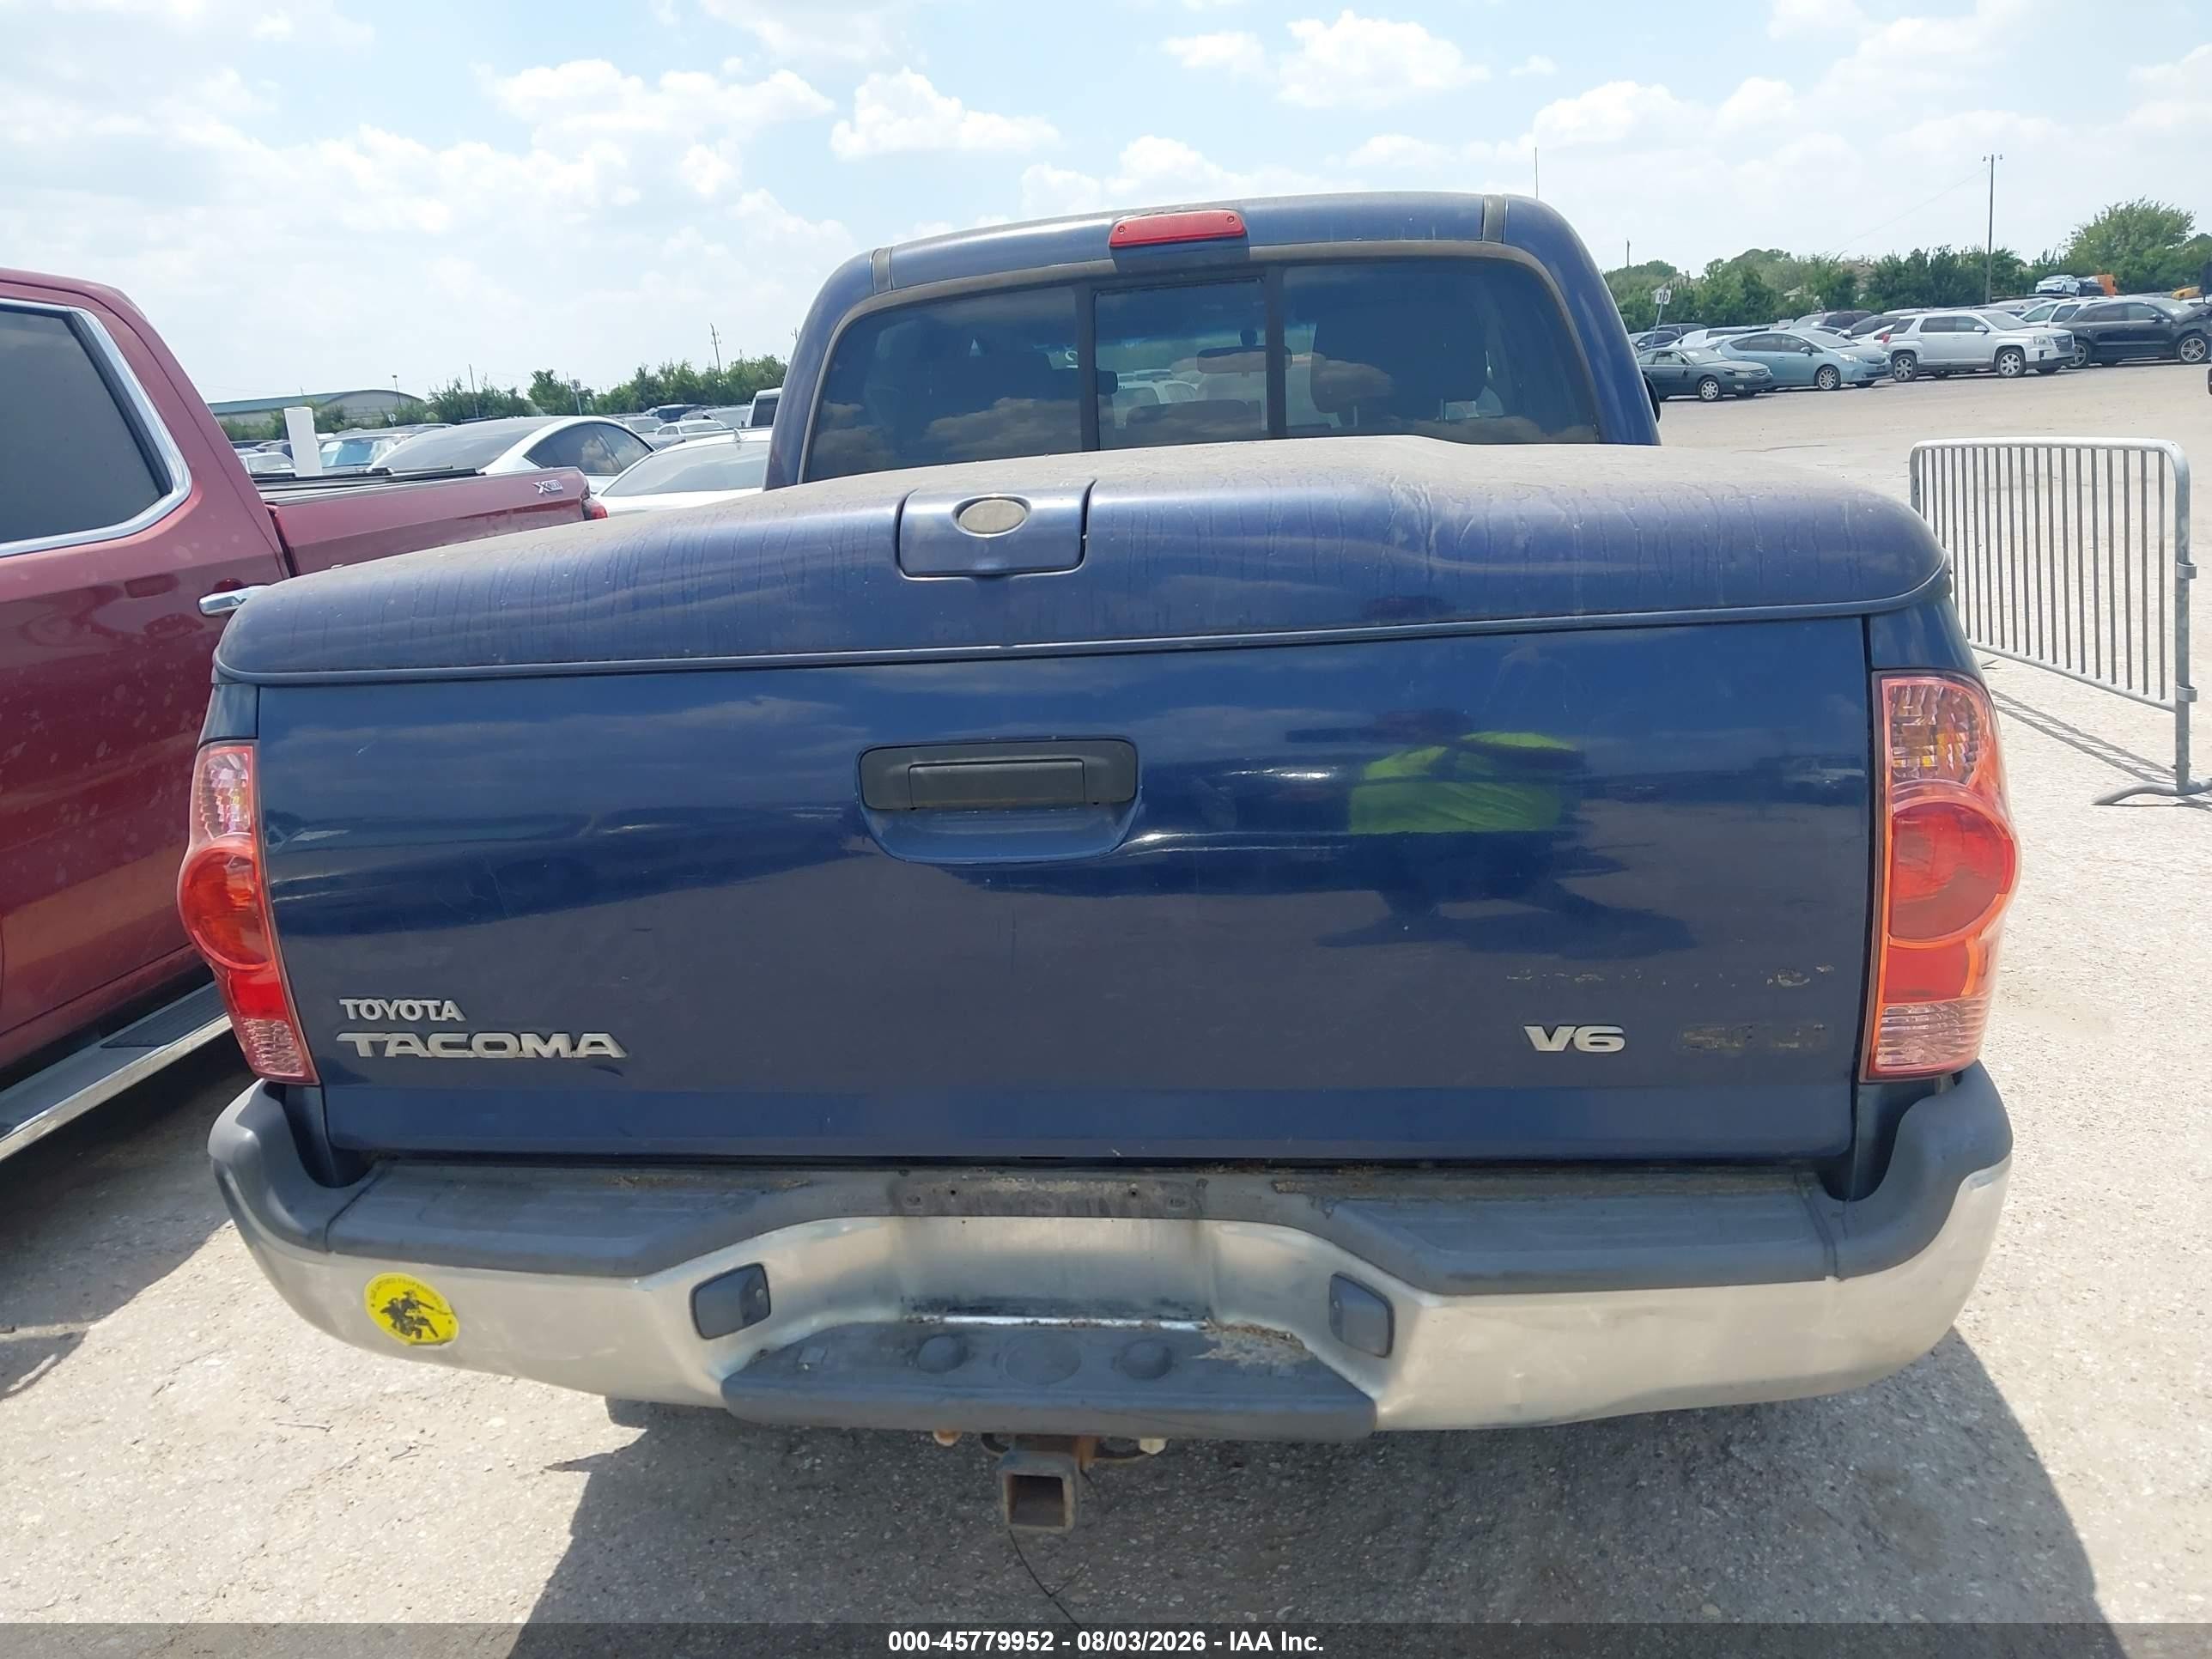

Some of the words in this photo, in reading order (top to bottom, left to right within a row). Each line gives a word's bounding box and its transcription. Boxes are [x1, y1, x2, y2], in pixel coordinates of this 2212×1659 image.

[338, 998, 466, 1022] TOYOTA
[336, 1032, 628, 1059] TACOMA
[1523, 1025, 1626, 1053] V6
